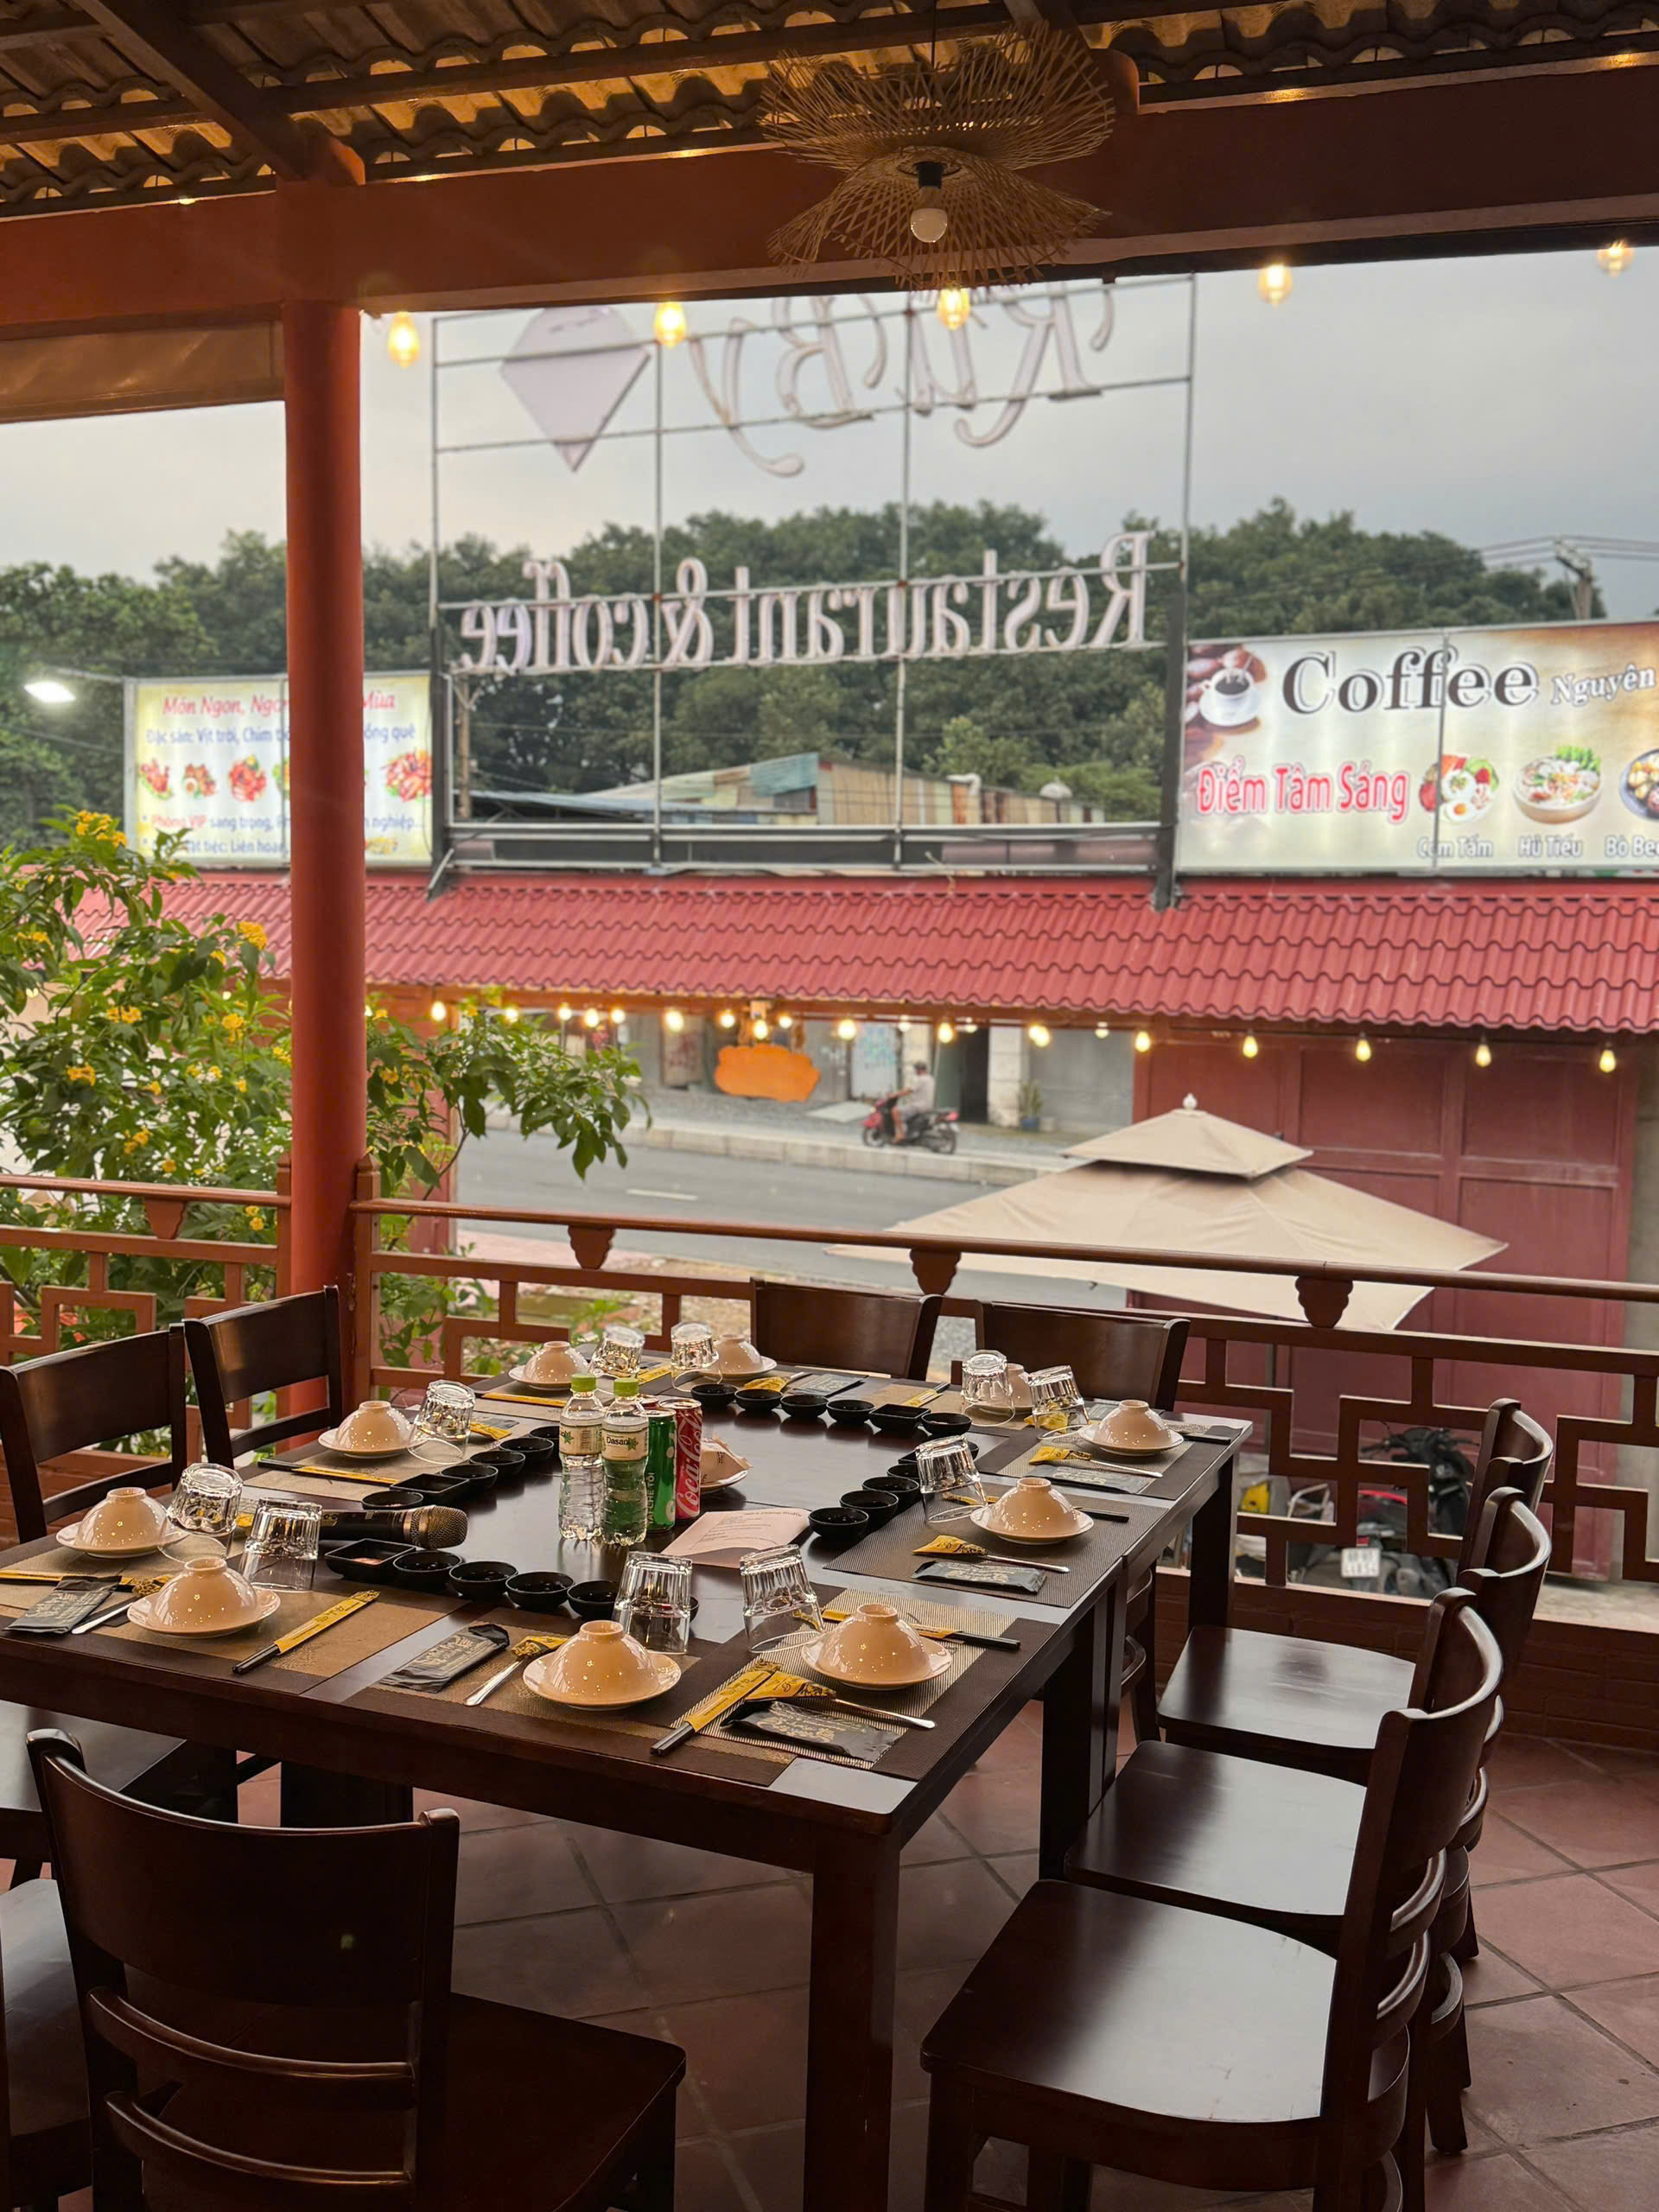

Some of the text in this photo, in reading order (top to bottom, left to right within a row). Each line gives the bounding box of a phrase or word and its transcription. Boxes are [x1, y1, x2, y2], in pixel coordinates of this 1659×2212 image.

[1282, 645, 1656, 714] Coffee Nguyên
[1198, 757, 1409, 823] Điểm Tâm Sáng
